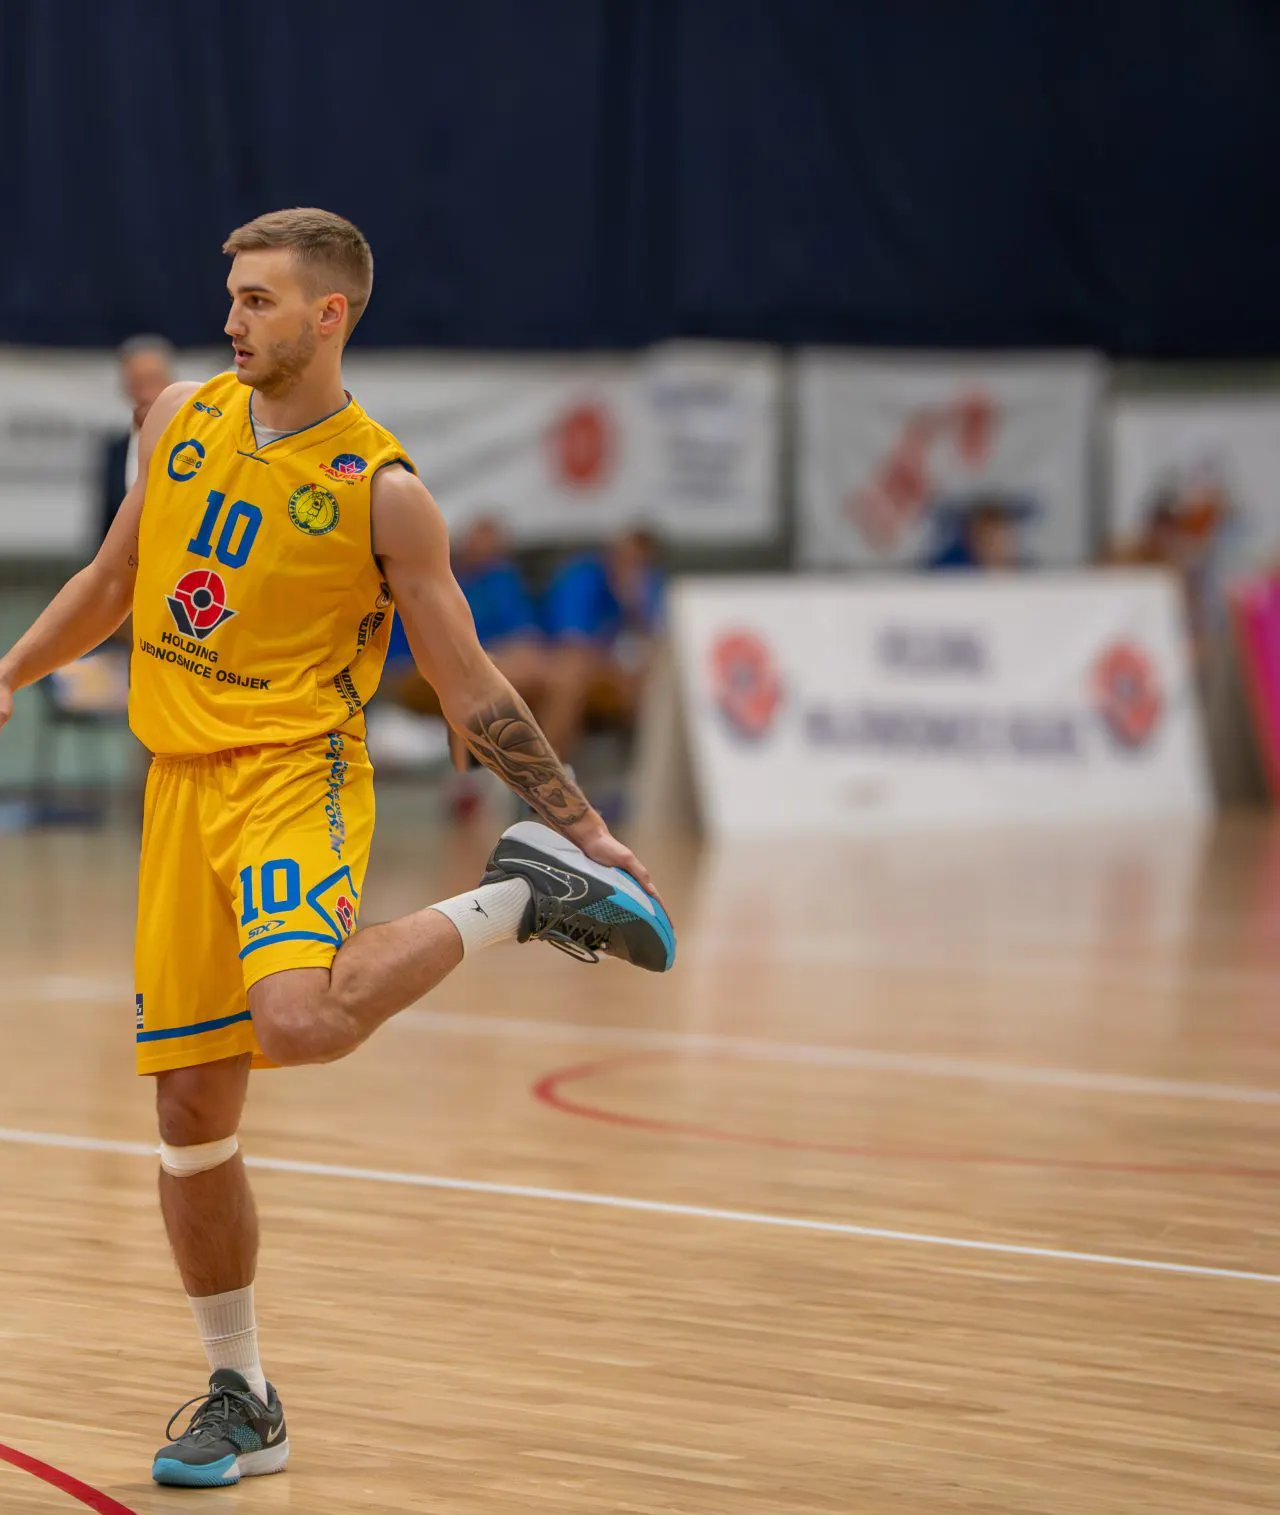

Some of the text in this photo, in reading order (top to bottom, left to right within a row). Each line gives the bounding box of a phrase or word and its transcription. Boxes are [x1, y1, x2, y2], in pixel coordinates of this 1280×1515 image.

[187, 489, 263, 569] 10
[139, 636, 271, 690] JEDNOSNICE OSIJEK
[161, 631, 219, 664] HOLDING
[240, 858, 301, 927] 10
